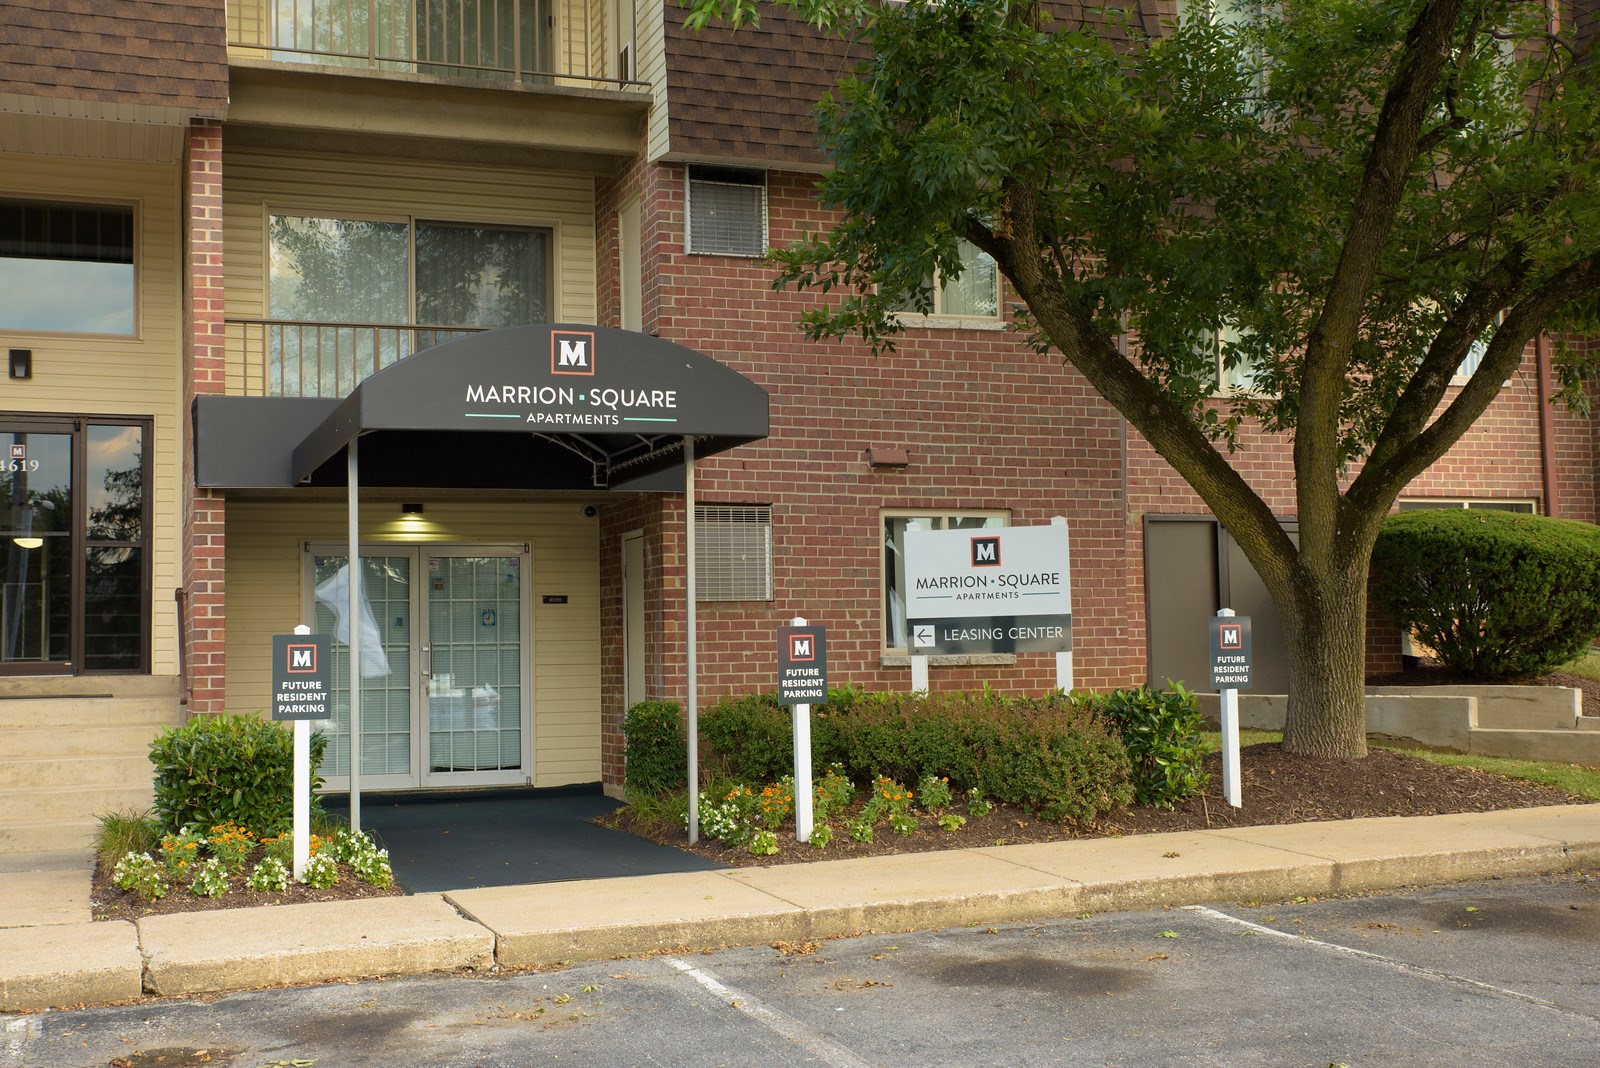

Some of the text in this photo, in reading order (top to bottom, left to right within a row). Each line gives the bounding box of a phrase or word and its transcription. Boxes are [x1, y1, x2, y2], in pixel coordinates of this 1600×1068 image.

[558, 340, 587, 367] M
[465, 384, 677, 410] MARRION SQUARE
[526, 412, 619, 425] APARTMENTS
[13, 447, 22, 456] M
[976, 543, 996, 561] M
[916, 572, 1060, 590] MARRION SQUARE
[956, 591, 1019, 601] APARTMENTS
[944, 626, 1063, 641] LEASING CENTER
[1224, 629, 1238, 644] M
[794, 640, 810, 656] M
[292, 650, 312, 667] M
[1217, 655, 1246, 664] FUTURE
[786, 668, 819, 677] FUTURE
[1213, 665, 1250, 674] RESIDENT
[782, 678, 824, 688] RESIDENT
[1215, 675, 1249, 683] PARKING
[282, 681, 322, 690] FUTURE
[276, 692, 327, 702] RESIDENT
[783, 689, 823, 698] PARKING
[278, 704, 325, 713] PARKING
